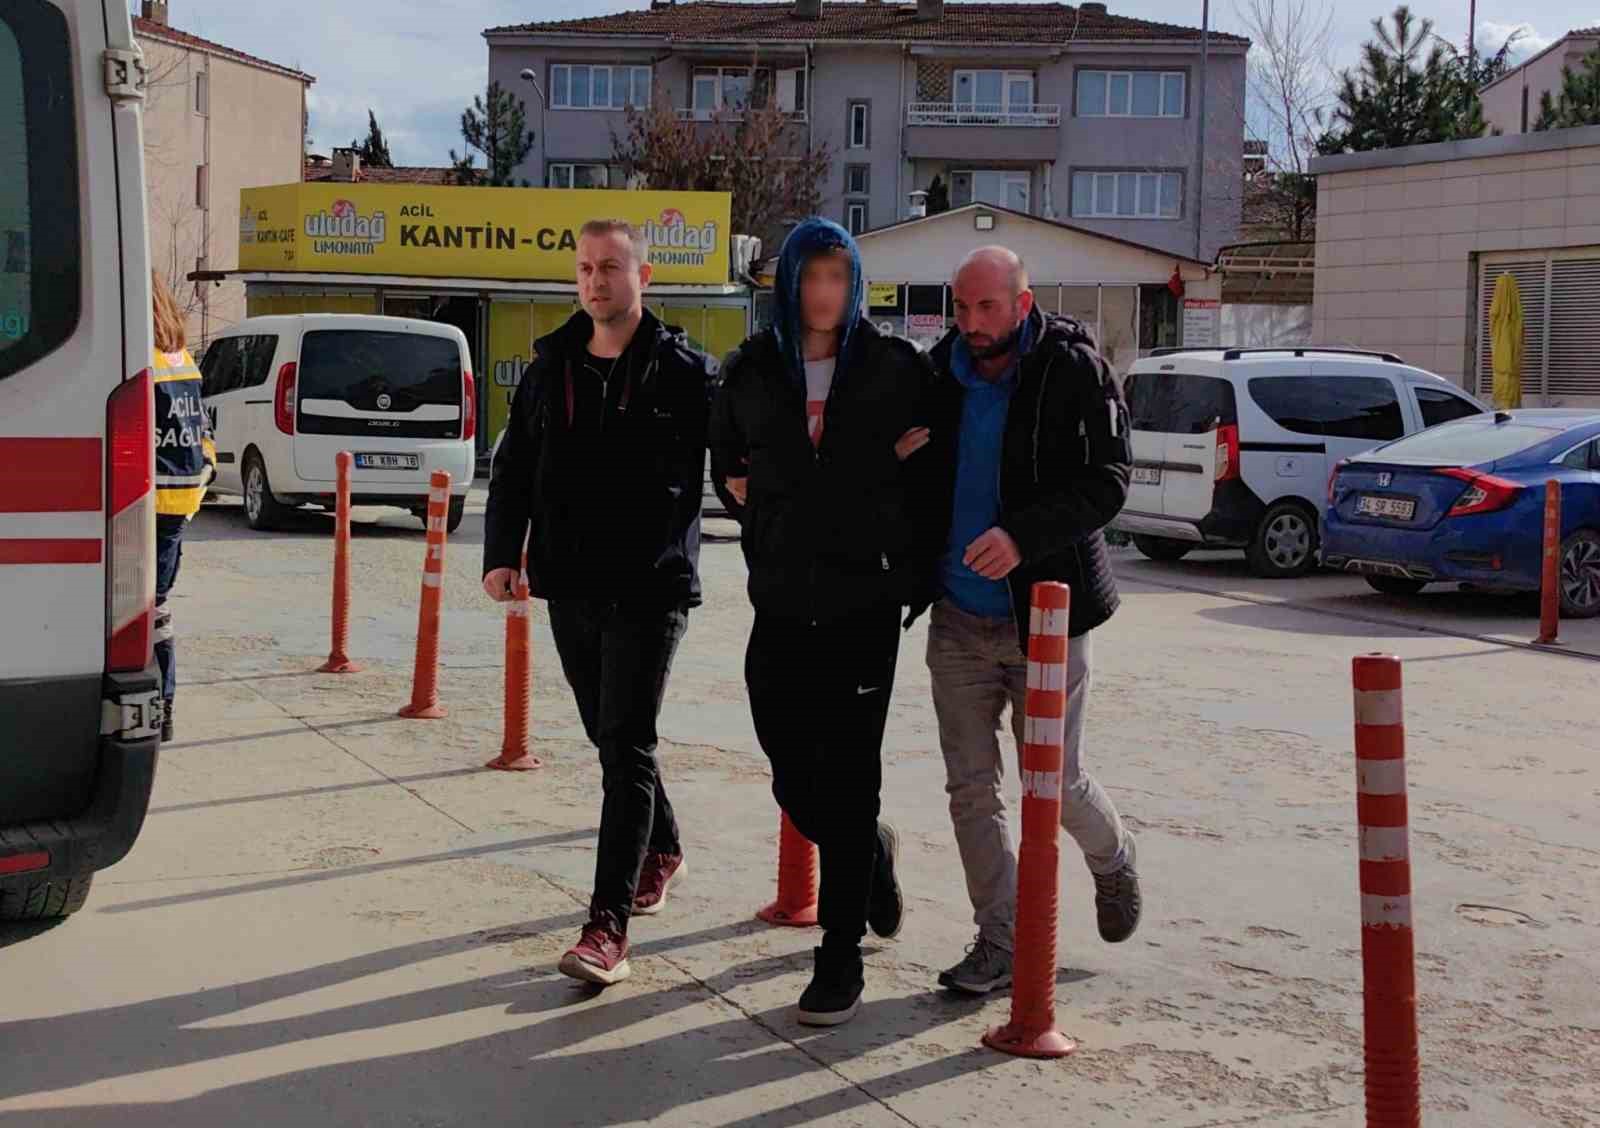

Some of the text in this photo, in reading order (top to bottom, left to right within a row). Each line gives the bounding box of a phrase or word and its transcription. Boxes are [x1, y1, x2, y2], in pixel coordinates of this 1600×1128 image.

[400, 203, 434, 217] ACİL
[304, 206, 386, 244] uludağ
[400, 222, 577, 251] KANTİN-CA
[641, 210, 718, 254] ludağ
[168, 391, 200, 419] ACİL
[154, 422, 201, 448] SAĞLI
